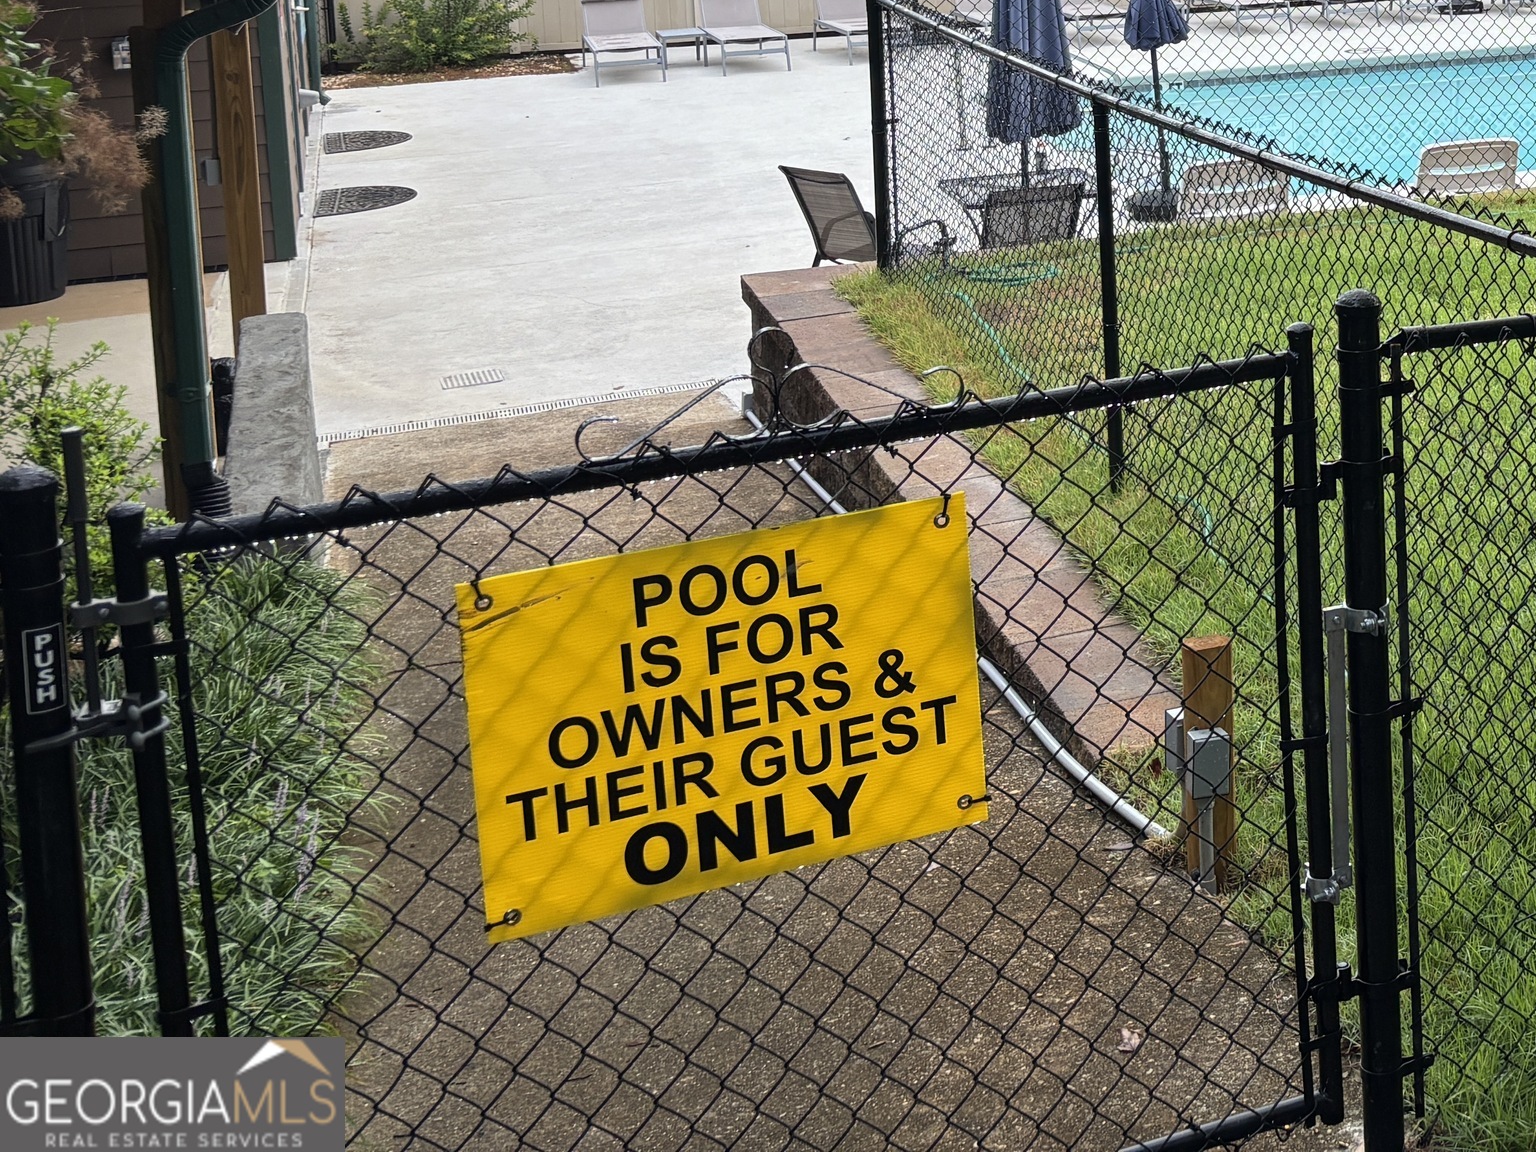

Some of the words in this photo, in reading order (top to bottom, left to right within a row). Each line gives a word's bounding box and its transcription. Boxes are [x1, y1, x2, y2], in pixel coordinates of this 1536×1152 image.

[632, 548, 823, 628] POOL
[34, 633, 57, 704] PUSH
[620, 635, 682, 694] IS
[705, 603, 844, 676] FOR
[547, 660, 852, 769] OWNERS
[873, 648, 917, 699] &
[505, 751, 720, 842] THEIR
[739, 695, 957, 787] GUEST
[623, 772, 868, 886] ONLY
